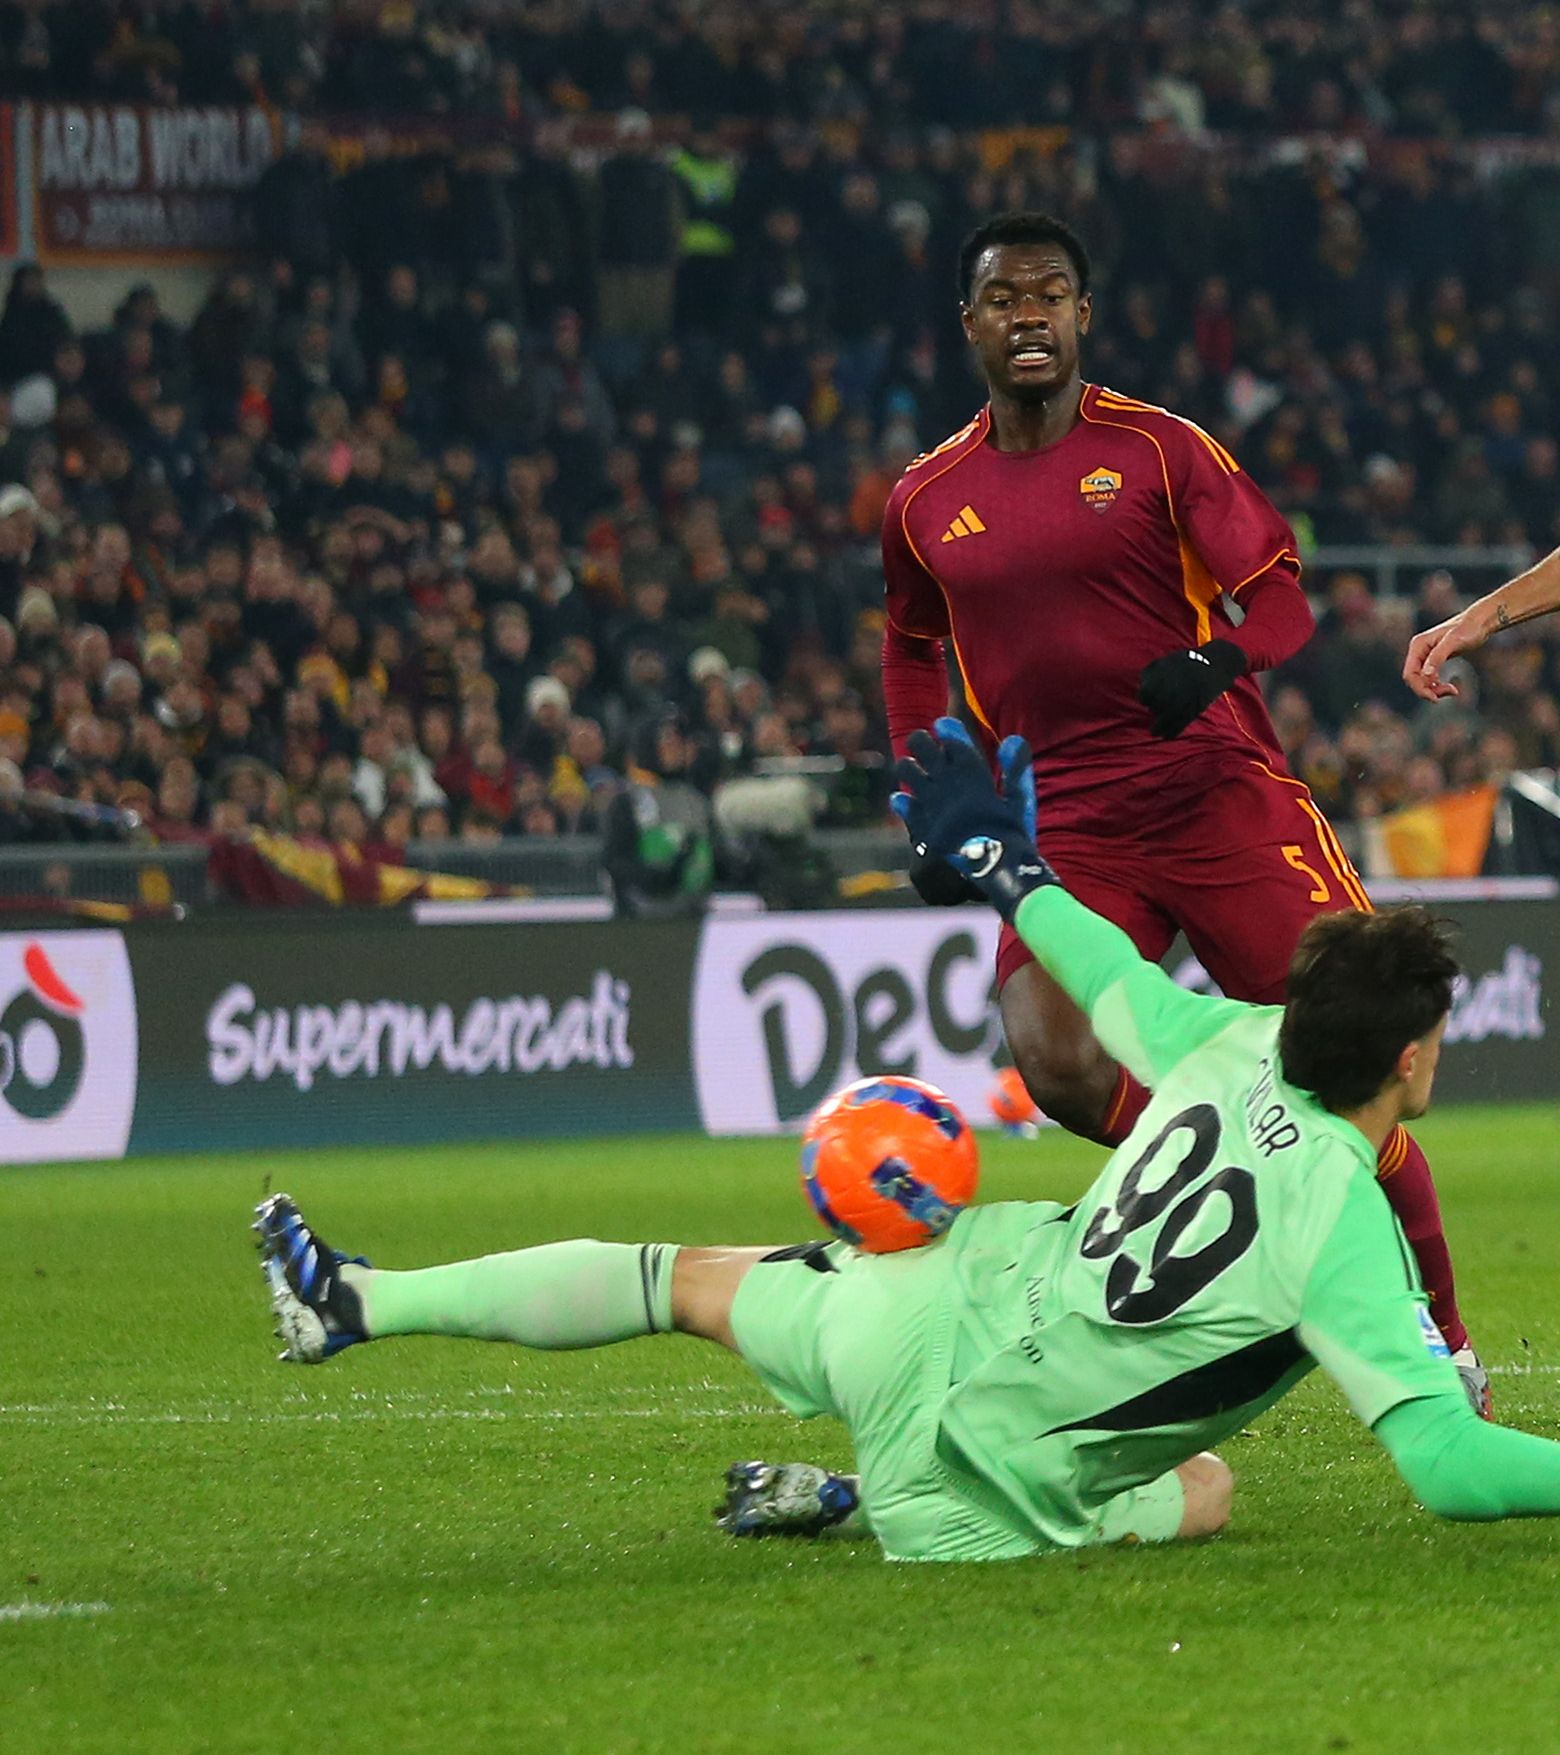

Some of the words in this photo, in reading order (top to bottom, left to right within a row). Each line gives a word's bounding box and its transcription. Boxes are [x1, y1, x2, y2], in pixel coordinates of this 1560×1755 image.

[41, 104, 140, 189] ARAB
[150, 105, 272, 187] WORLD
[1281, 845, 1331, 903] 5
[207, 968, 634, 1091] Supermercati
[1080, 1102, 1260, 1324] 99
